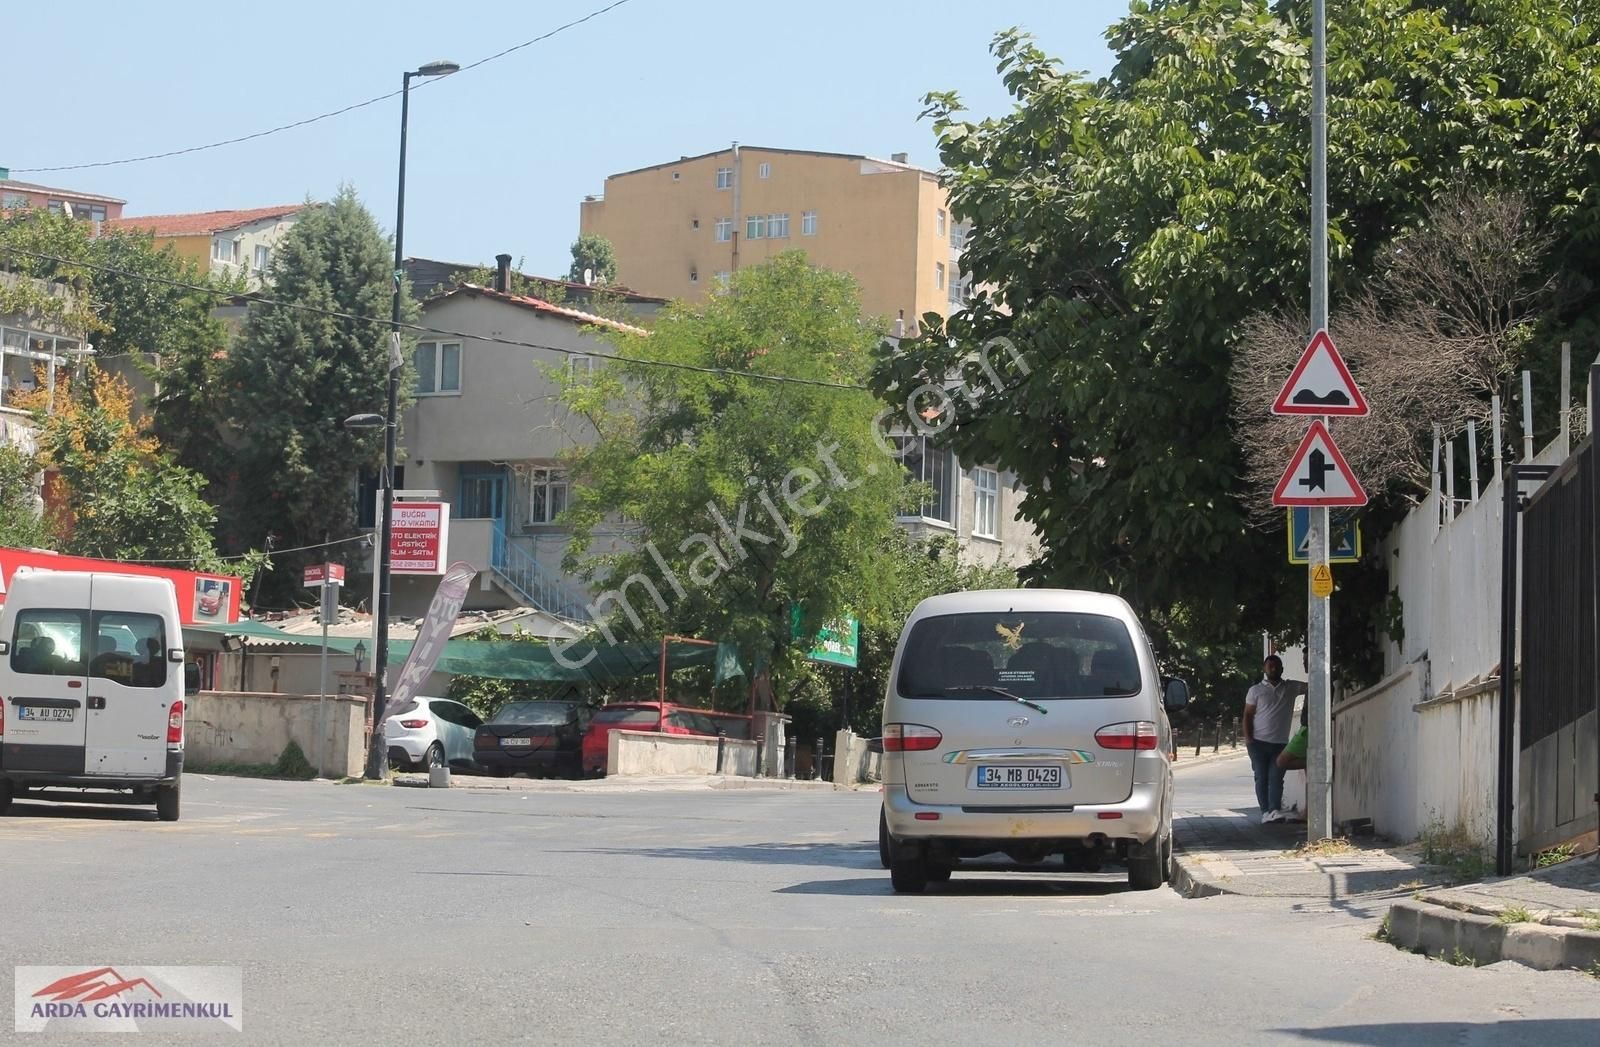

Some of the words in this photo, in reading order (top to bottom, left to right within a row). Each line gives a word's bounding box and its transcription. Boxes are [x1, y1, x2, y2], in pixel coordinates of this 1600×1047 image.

[401, 510, 426, 518] BUĞRA
[404, 532, 437, 540] ELEKTRİK
[397, 540, 427, 549] LASTİKÇİ
[428, 594, 461, 621] OTO
[25, 708, 35, 717] 34
[39, 708, 50, 717] AU
[52, 709, 72, 718] 0274
[986, 769, 1001, 782] 34
[1007, 769, 1023, 782] MB
[1027, 769, 1058, 782] 0429
